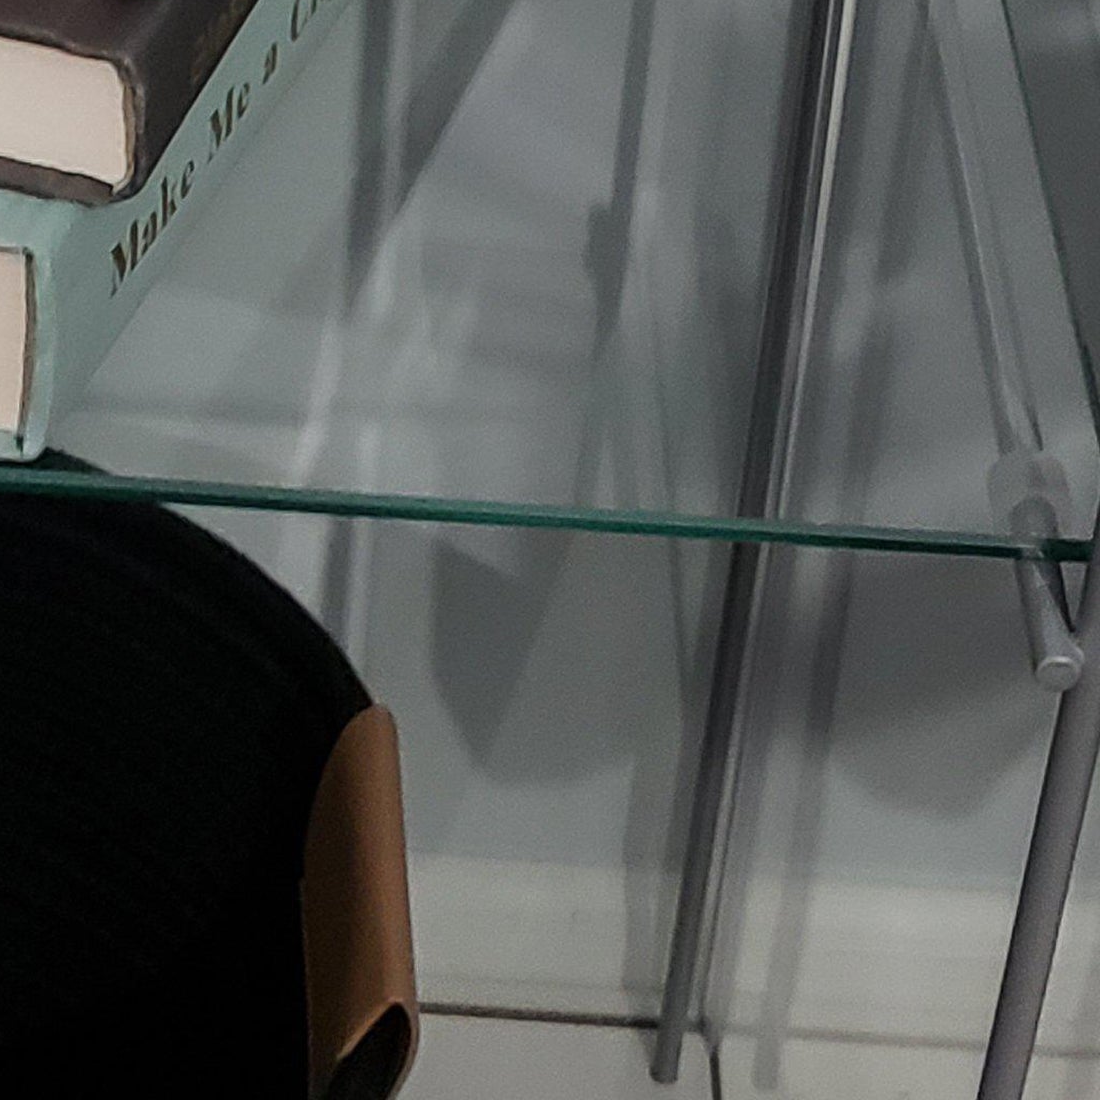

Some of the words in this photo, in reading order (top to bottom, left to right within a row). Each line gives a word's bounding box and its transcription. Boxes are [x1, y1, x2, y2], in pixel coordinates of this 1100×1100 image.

[110, 160, 195, 298] Make
[207, 82, 251, 164] Me
[262, 42, 278, 85] a
